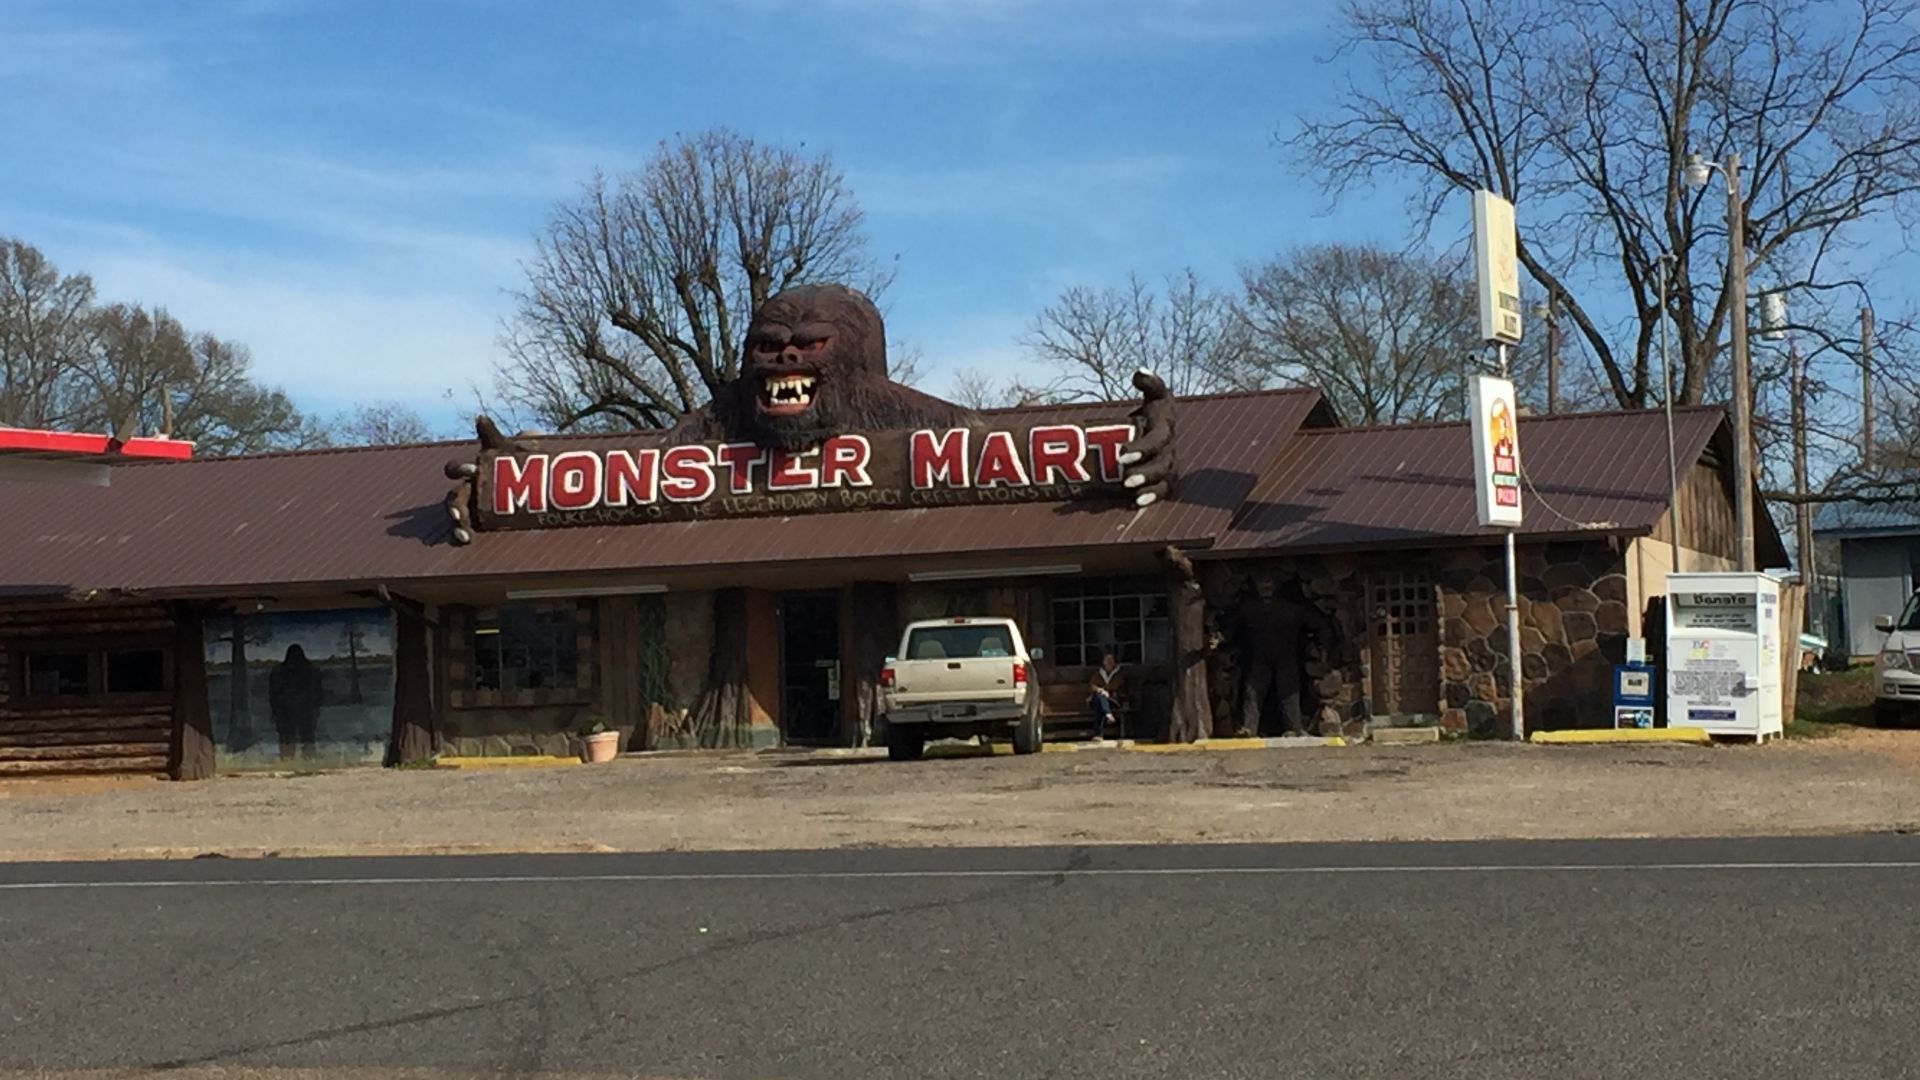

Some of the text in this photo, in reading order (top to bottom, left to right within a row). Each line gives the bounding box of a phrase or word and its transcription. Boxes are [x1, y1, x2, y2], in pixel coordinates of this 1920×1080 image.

[494, 425, 1136, 515] MONSTER MART
[646, 503, 672, 519] OF
[680, 501, 717, 517] THE
[723, 491, 829, 513] LEGENDARY
[977, 484, 1083, 502] MONSTER
[1693, 593, 1747, 605] Donate
